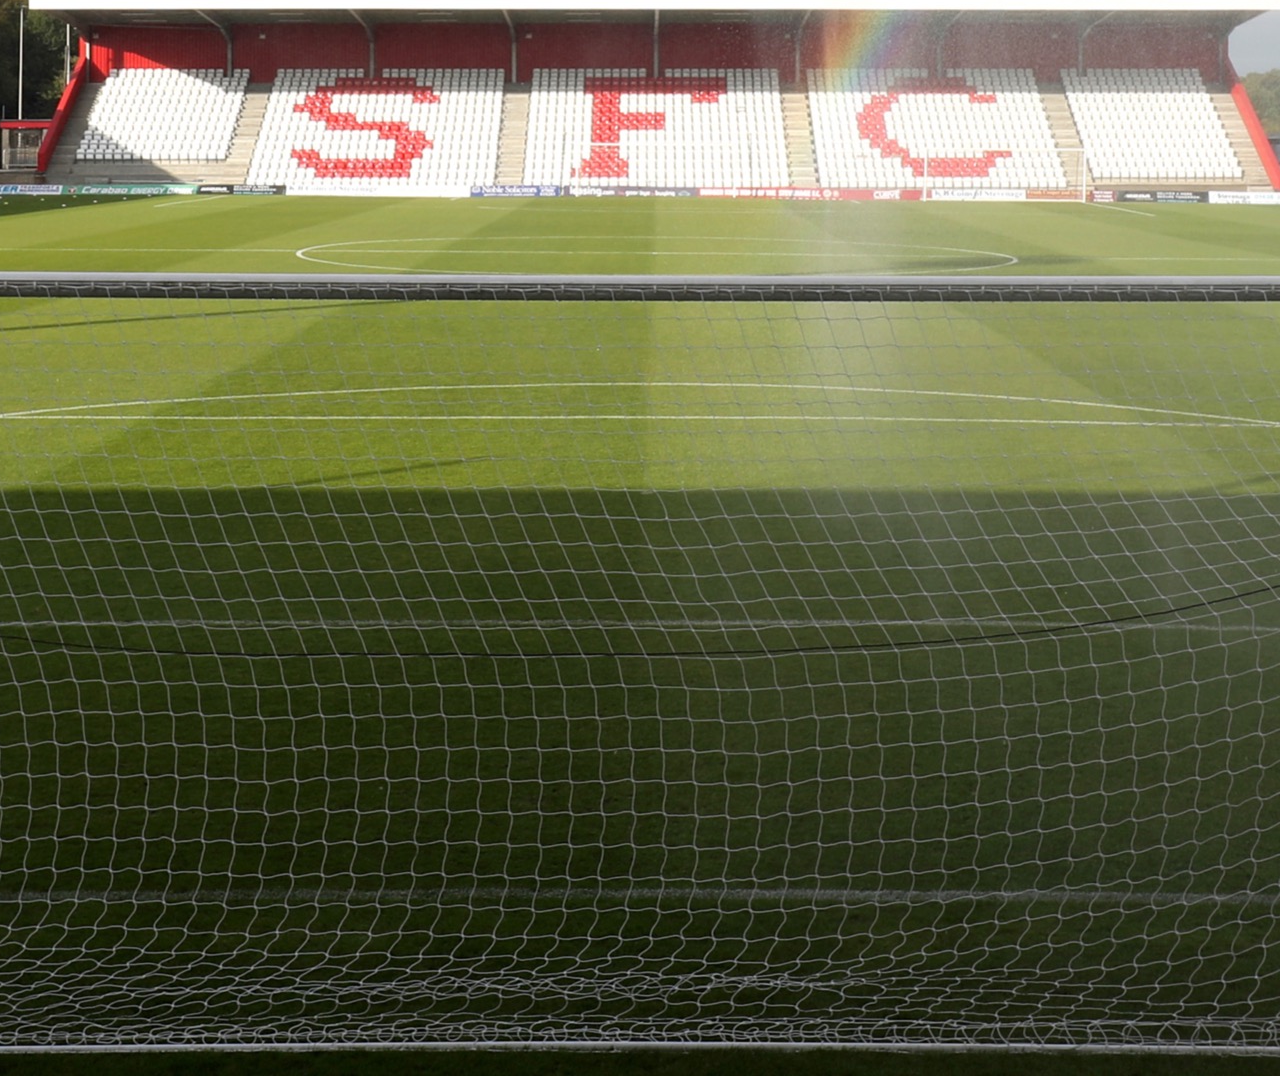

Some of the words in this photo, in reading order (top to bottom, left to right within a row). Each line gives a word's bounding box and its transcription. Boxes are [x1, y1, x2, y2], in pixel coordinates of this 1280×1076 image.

[292, 76, 440, 178] S
[571, 76, 727, 178] F
[857, 76, 1011, 178] C
[81, 186, 128, 194] Carabao
